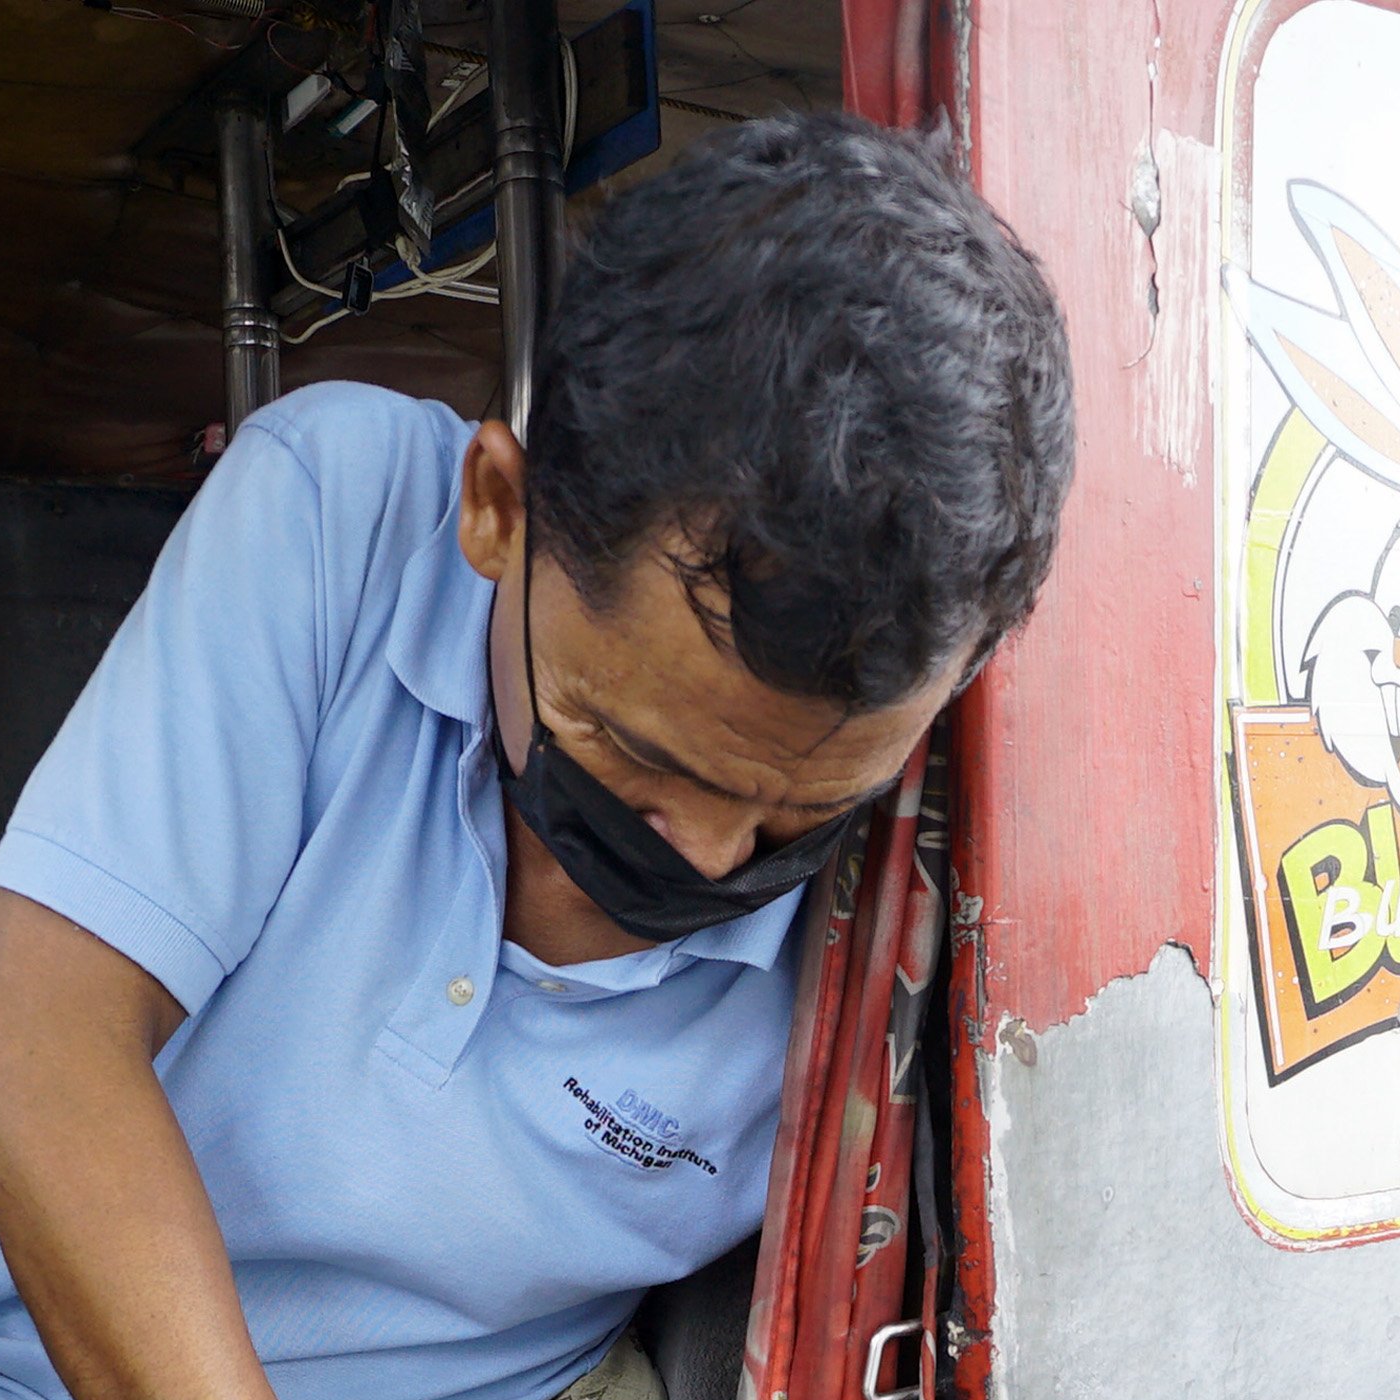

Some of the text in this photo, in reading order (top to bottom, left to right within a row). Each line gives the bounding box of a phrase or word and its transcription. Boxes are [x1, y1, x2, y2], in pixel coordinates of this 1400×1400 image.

[563, 1077, 718, 1176] Rehabilitation Institute
[616, 1088, 681, 1137] DMC
[584, 1118, 673, 1167] of Michigan
